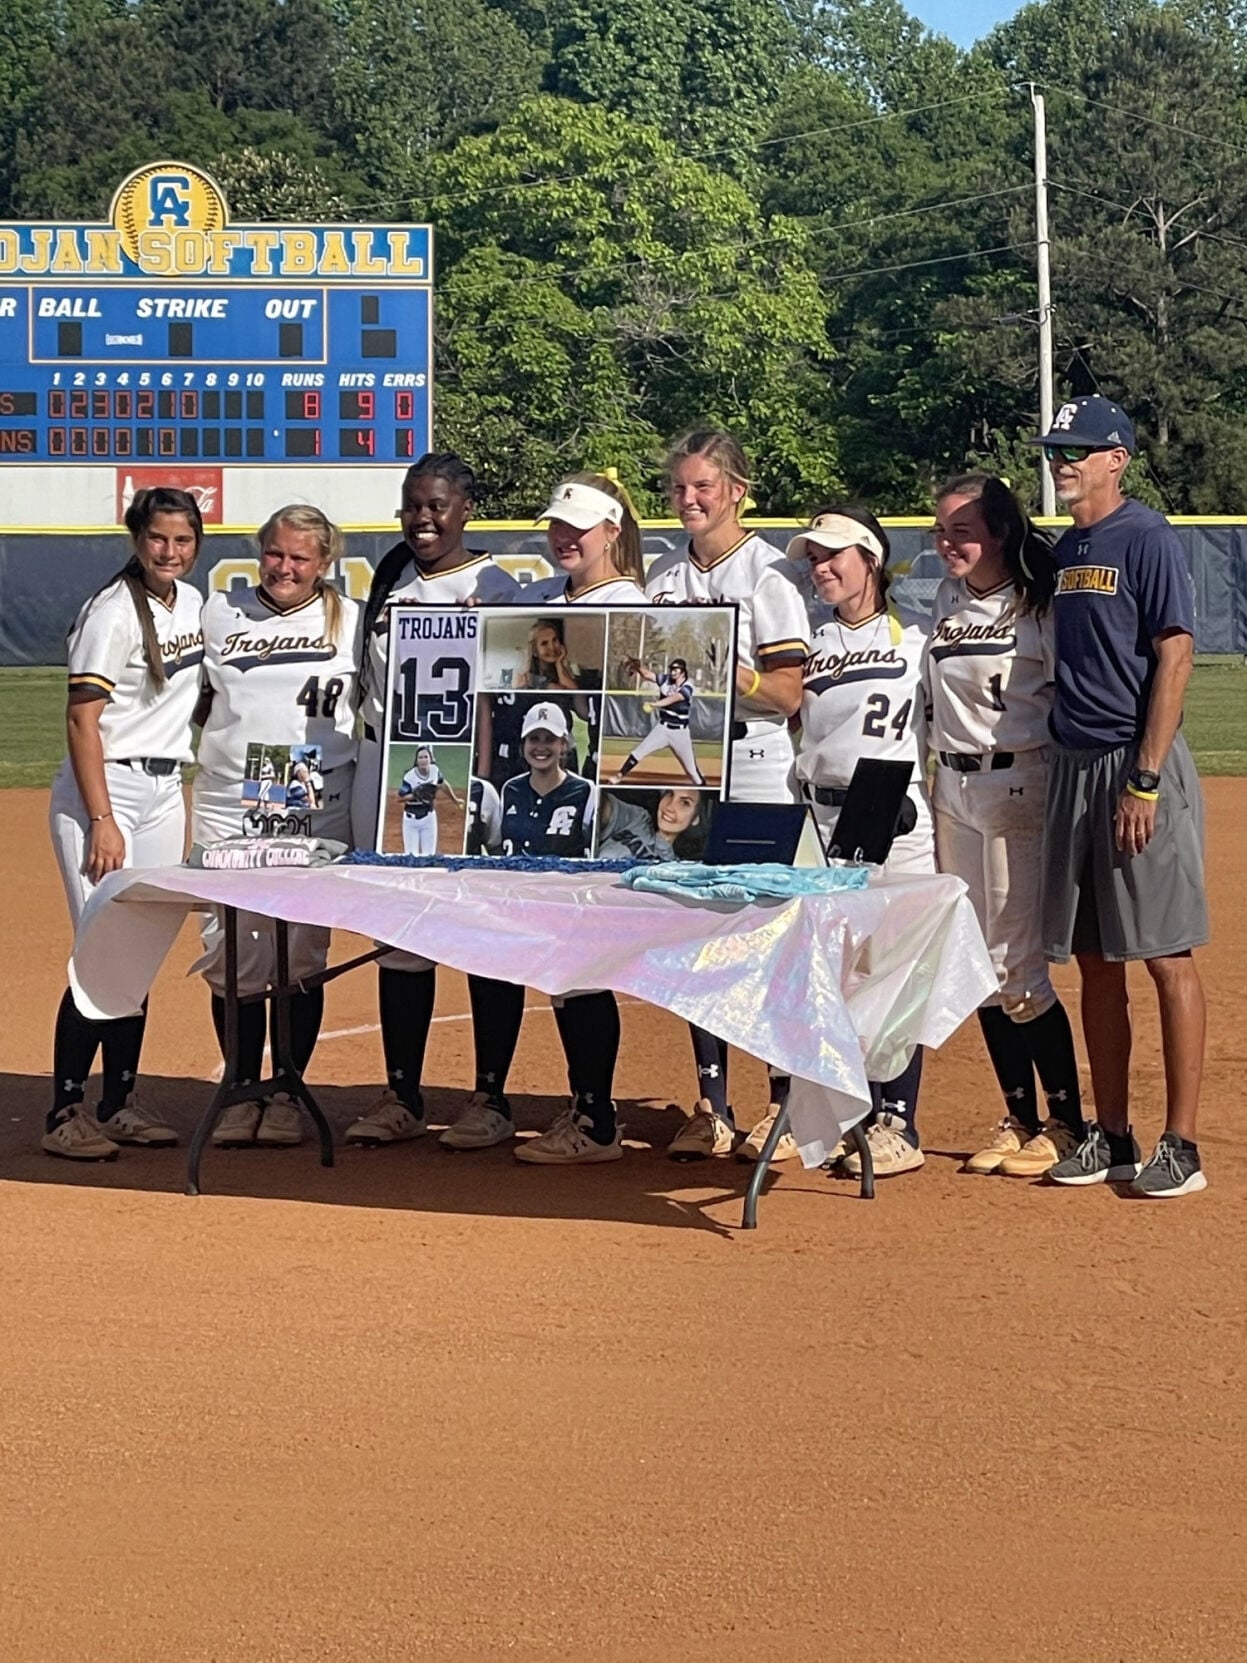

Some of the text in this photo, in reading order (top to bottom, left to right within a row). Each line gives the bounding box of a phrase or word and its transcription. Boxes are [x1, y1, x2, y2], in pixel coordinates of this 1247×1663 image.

[0, 230, 424, 276] OJAN SOFTBALL
[38, 298, 102, 317] BALL
[136, 298, 228, 319] STRIKE
[265, 299, 317, 319] OUT
[53, 372, 426, 387] 1 2 3 4 5 6 7 8 9 10 RUNS HITS ERRS
[1061, 568, 1114, 591] SOFTBALL
[398, 616, 478, 639] TROJANS
[932, 617, 1010, 650] Trojans
[221, 631, 323, 660] Trojans
[802, 649, 896, 679] Trojans
[297, 676, 344, 717] 48
[399, 657, 470, 737] 13
[988, 674, 1007, 711] 1
[862, 693, 912, 741] 24
